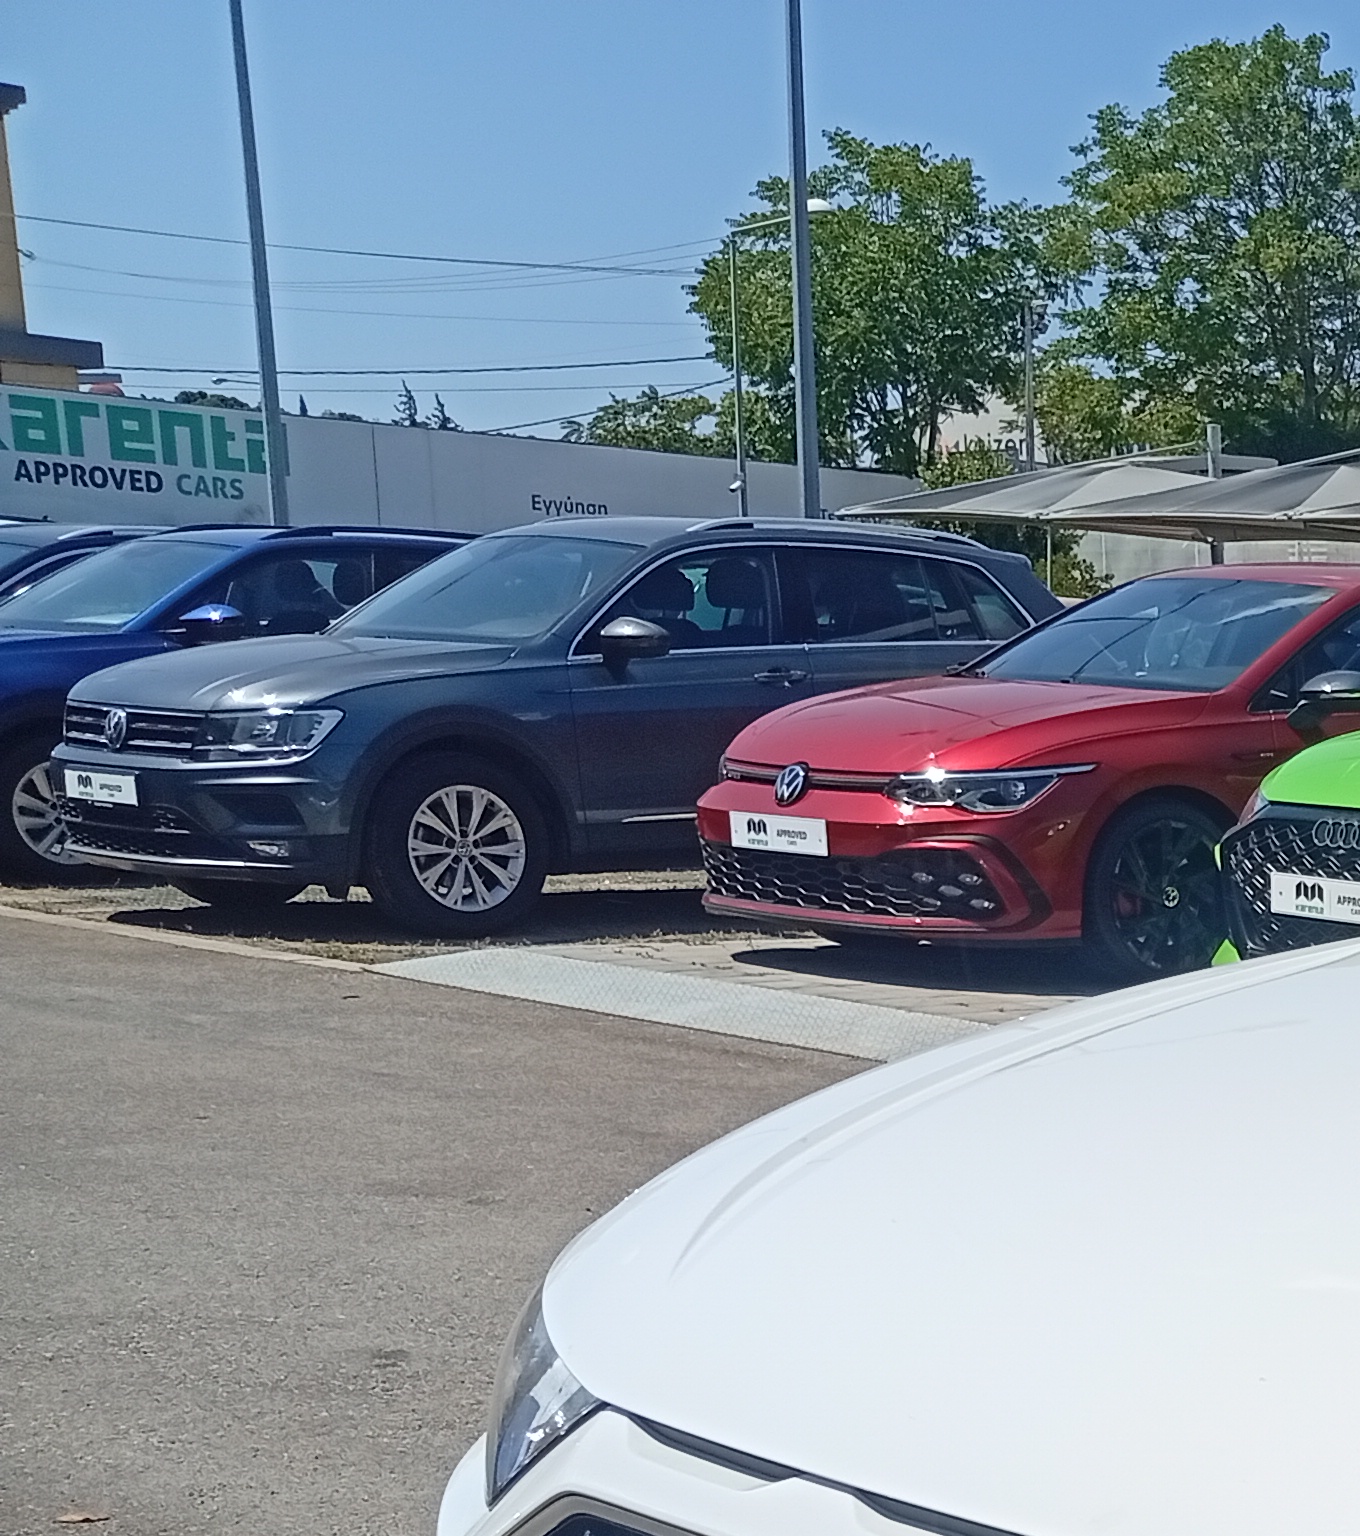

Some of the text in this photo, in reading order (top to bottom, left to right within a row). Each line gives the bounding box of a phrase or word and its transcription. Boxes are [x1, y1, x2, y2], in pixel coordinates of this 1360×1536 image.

[0, 393, 290, 477] arenta
[14, 459, 245, 500] APPROVED CARS
